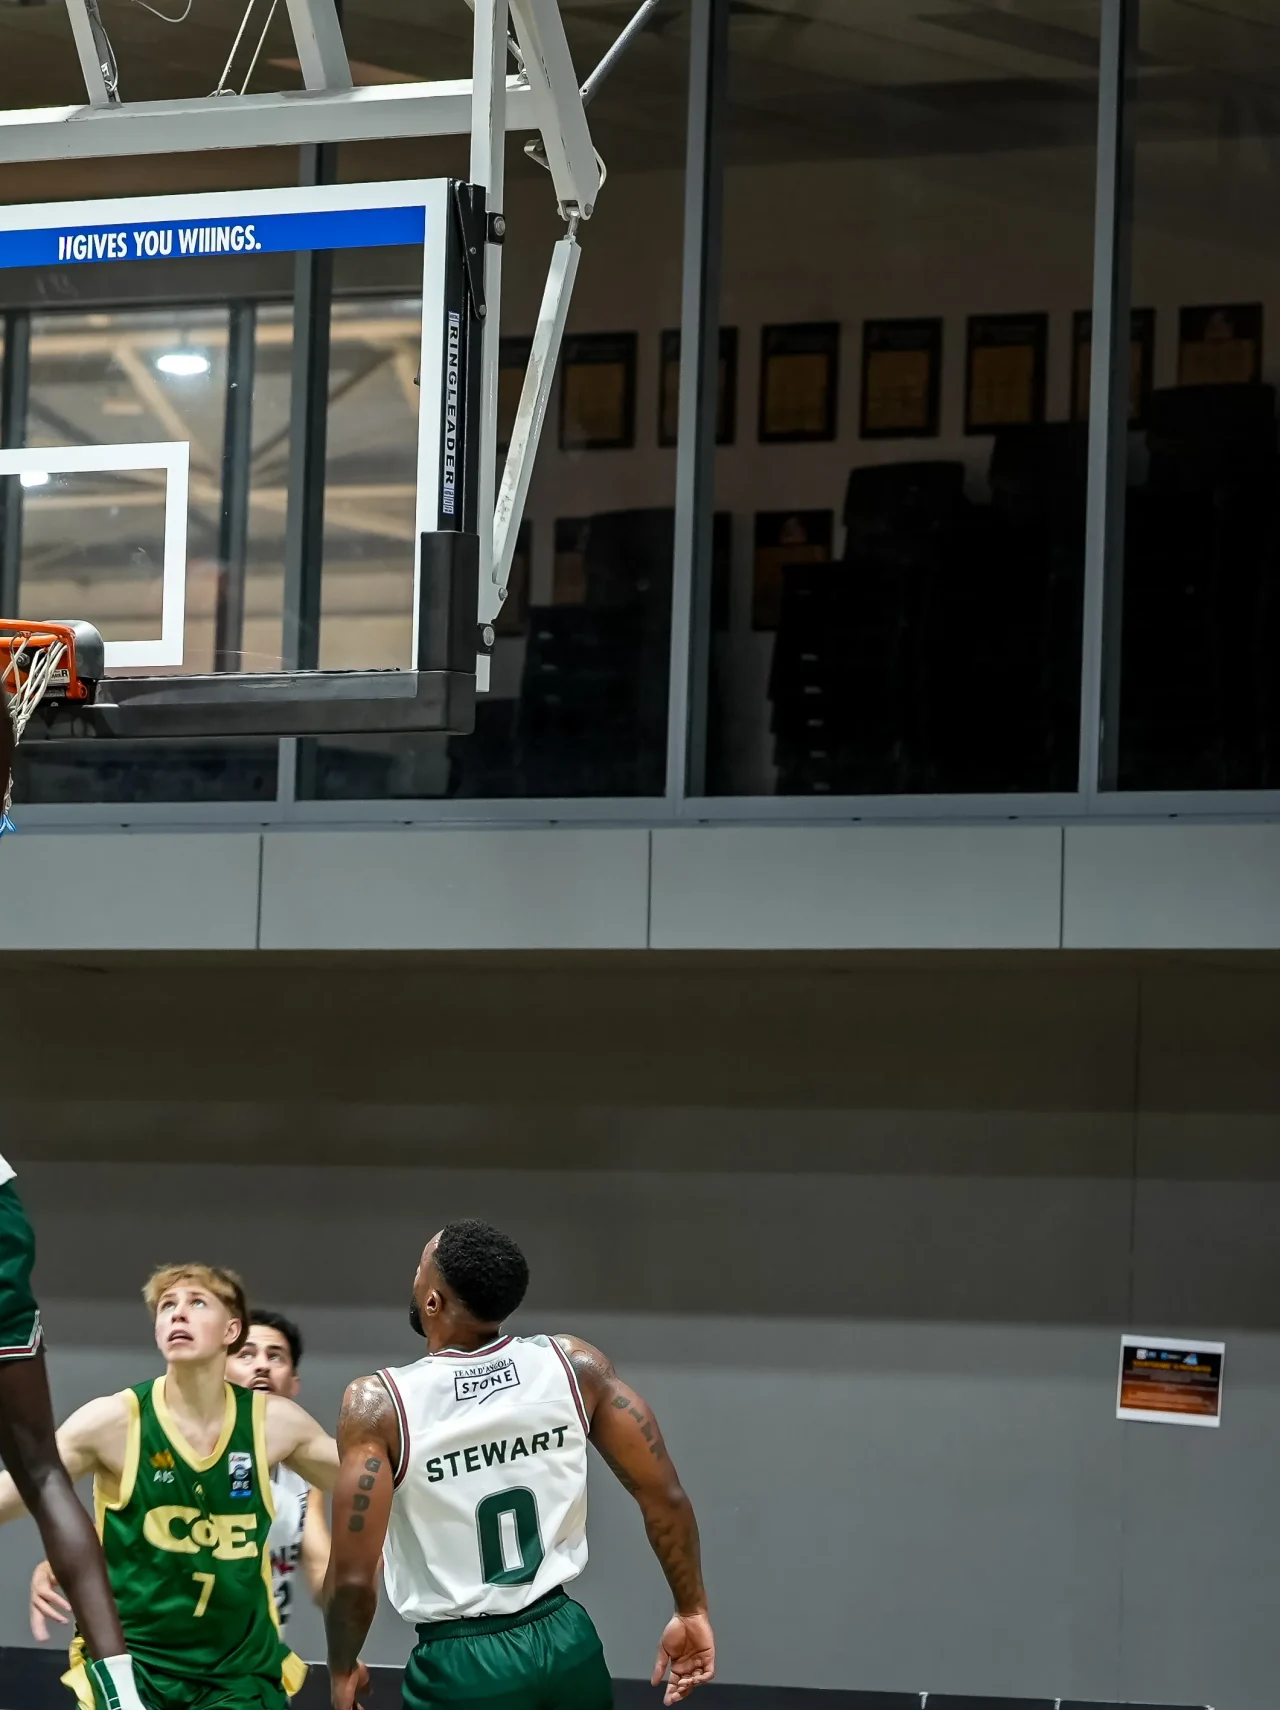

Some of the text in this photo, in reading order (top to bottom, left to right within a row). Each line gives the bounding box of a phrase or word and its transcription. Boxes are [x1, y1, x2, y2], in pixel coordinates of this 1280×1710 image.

[133, 229, 173, 257] YOU
[177, 224, 262, 254] WIIINGS.
[445, 325, 459, 484] RINGLEADER
[453, 1369, 477, 1378] TEAM
[462, 1369, 513, 1394] STONE
[426, 1424, 569, 1483] STEWART
[475, 1485, 545, 1588] 0
[192, 1571, 216, 1618] 7
